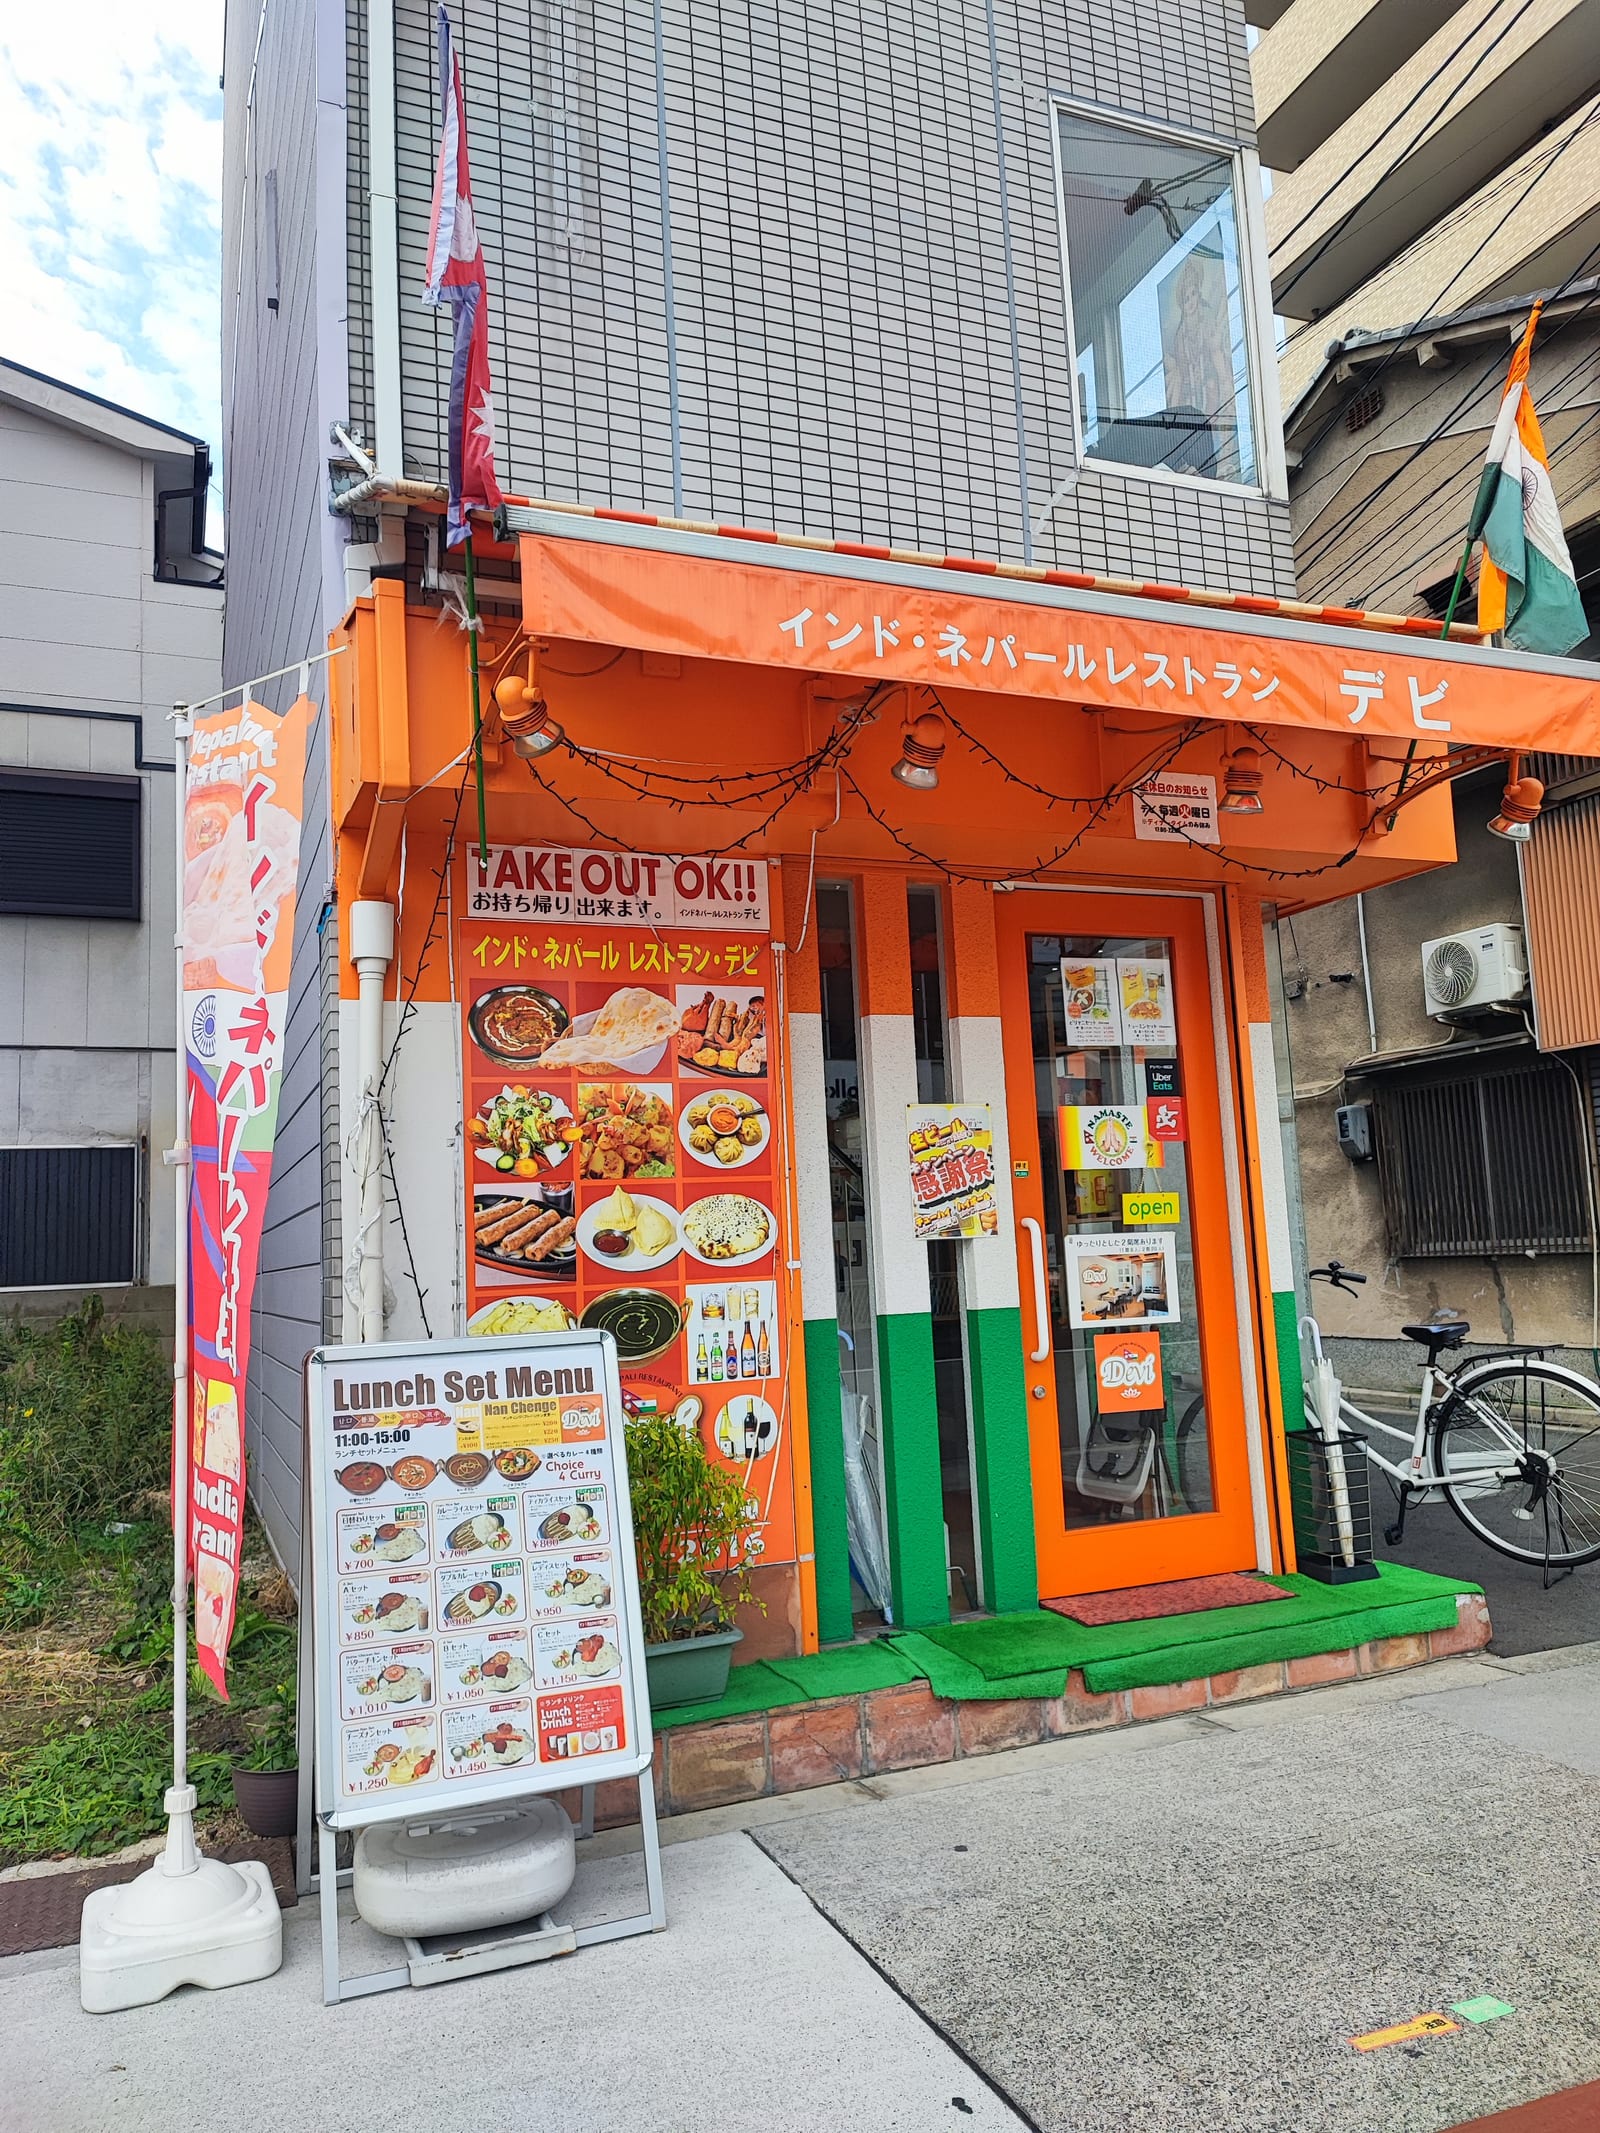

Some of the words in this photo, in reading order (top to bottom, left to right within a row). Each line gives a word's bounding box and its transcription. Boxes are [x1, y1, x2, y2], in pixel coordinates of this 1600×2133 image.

[778, 606, 1281, 702] インド・ネパールレストラン
[1338, 667, 1452, 733] デビ
[471, 848, 573, 893] TAKE
[580, 854, 661, 897] OUT
[674, 859, 757, 903] OK!!
[472, 935, 620, 971] インド・ネパール
[628, 941, 760, 976] レストラン・デビ
[1152, 1073, 1172, 1081] Uber
[1153, 1082, 1173, 1090] Eats
[1087, 1109, 1133, 1130] NAMASTE
[909, 1118, 968, 1154] 生ビール
[1090, 1146, 1134, 1166] WELCOME
[912, 1150, 992, 1202] 感謝祭
[1129, 1202, 1173, 1220] open
[1102, 1356, 1154, 1385] Devi
[333, 1373, 436, 1411] Lunch
[443, 1370, 498, 1403] Set
[505, 1366, 595, 1399] Menu
[484, 1403, 509, 1416] Nan
[510, 1400, 557, 1414] Chenge
[334, 1429, 410, 1447] 11:00-15:00
[545, 1460, 584, 1472] Choice
[559, 1471, 565, 1480] 4
[570, 1470, 601, 1481] Curry
[345, 1559, 374, 1570] ¥700
[535, 1606, 562, 1616] ¥950
[346, 1629, 374, 1641] ¥850
[542, 1673, 577, 1686] ¥1,150
[447, 1688, 484, 1701] ¥1,050
[349, 1702, 388, 1716] ¥1,010
[541, 1705, 571, 1720] Lunch
[541, 1716, 573, 1730] Drinks
[449, 1761, 487, 1775] ¥1,450
[349, 1777, 388, 1792] ¥1,250
